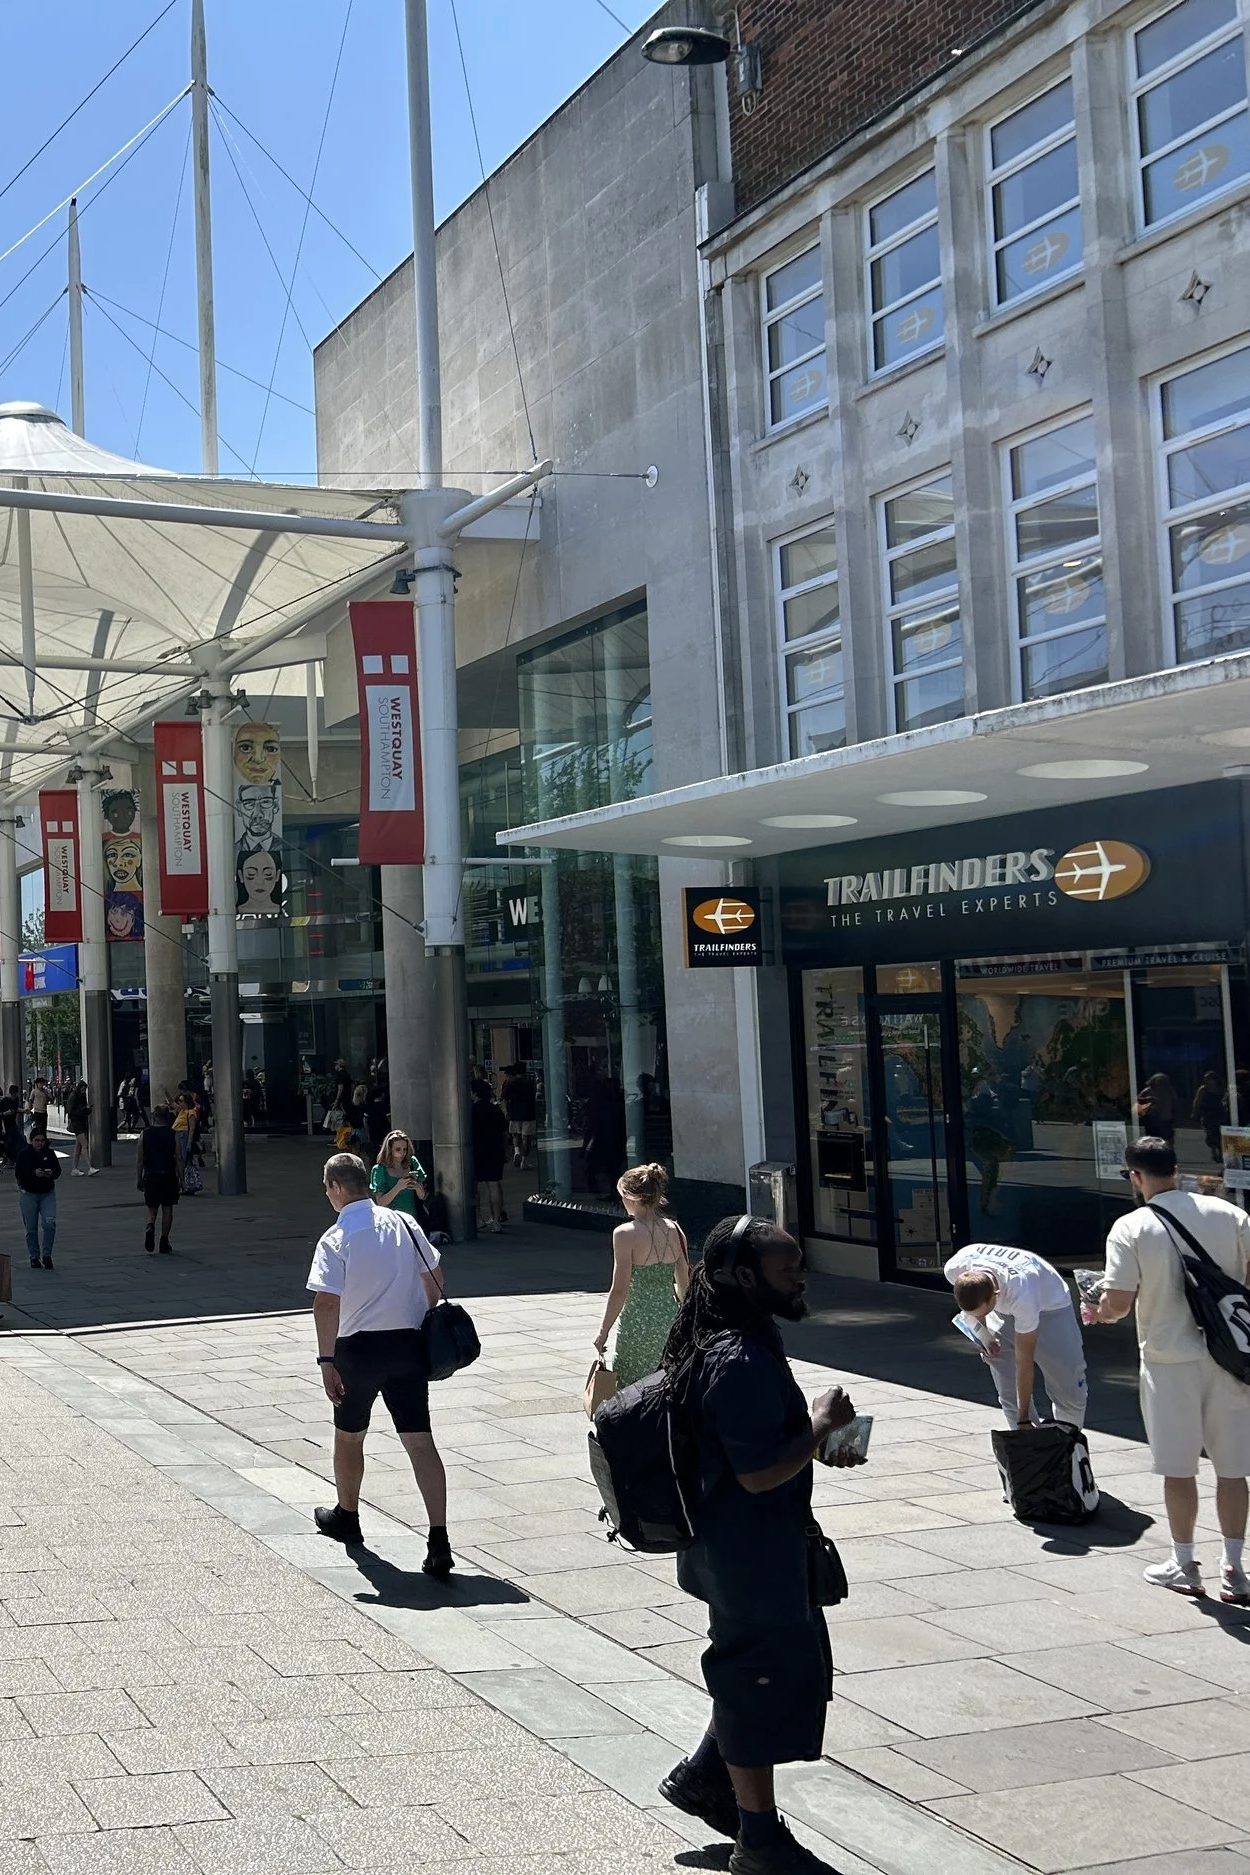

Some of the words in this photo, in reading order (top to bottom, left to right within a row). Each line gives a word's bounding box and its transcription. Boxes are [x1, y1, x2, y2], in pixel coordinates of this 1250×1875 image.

[378, 697, 390, 800] SOUTHAMPTON
[390, 697, 403, 780] WESTQUAY
[171, 792, 182, 867] SOUTHAMPTON
[181, 791, 192, 852] WESTQUAY
[61, 845, 69, 894] WESTQUAY
[824, 848, 1054, 907] TRAILFINDERS
[831, 912, 861, 928] THE
[876, 903, 946, 923] TRAVEL
[961, 891, 1058, 915] EXPERTS
[693, 943, 757, 952] TRAILFINDERS
[981, 964, 1030, 976] WORLDWIDE
[1030, 962, 1059, 972] TRAVEL
[1102, 957, 1142, 968] PREMIUM
[1145, 954, 1179, 965] TRAVEL
[1192, 951, 1228, 963] CRUISE
